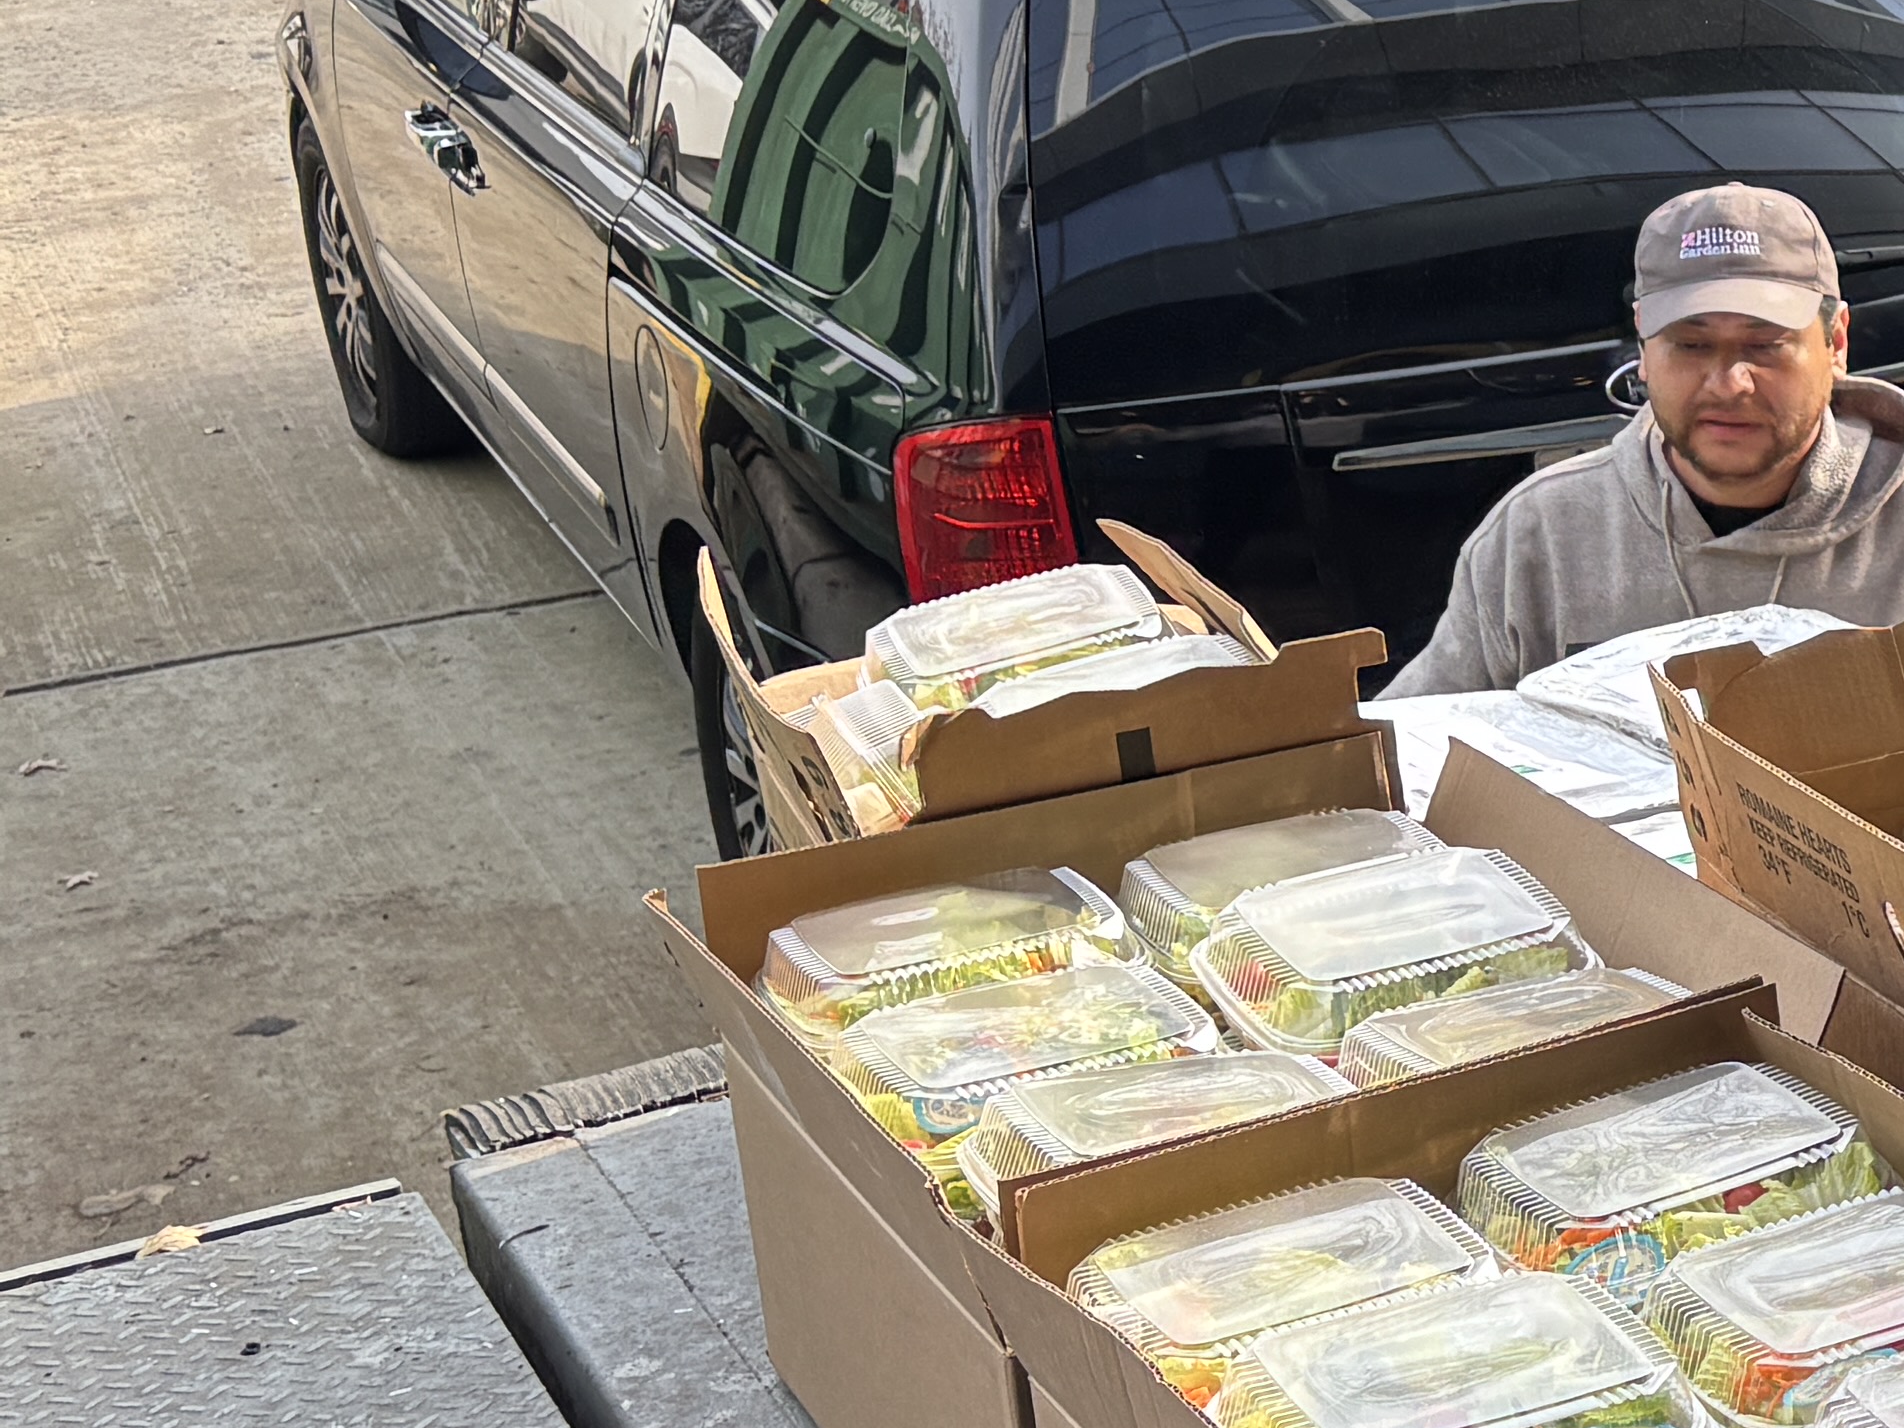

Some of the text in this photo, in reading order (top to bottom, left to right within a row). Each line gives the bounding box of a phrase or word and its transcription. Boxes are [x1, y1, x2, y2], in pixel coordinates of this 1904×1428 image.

[1679, 242, 1761, 260] Garden Inn
[1696, 227, 1760, 246] Hilton
[1736, 781, 1852, 875] ROMAINE HEARTS
[1776, 832, 1860, 904] REFRIGERATED
